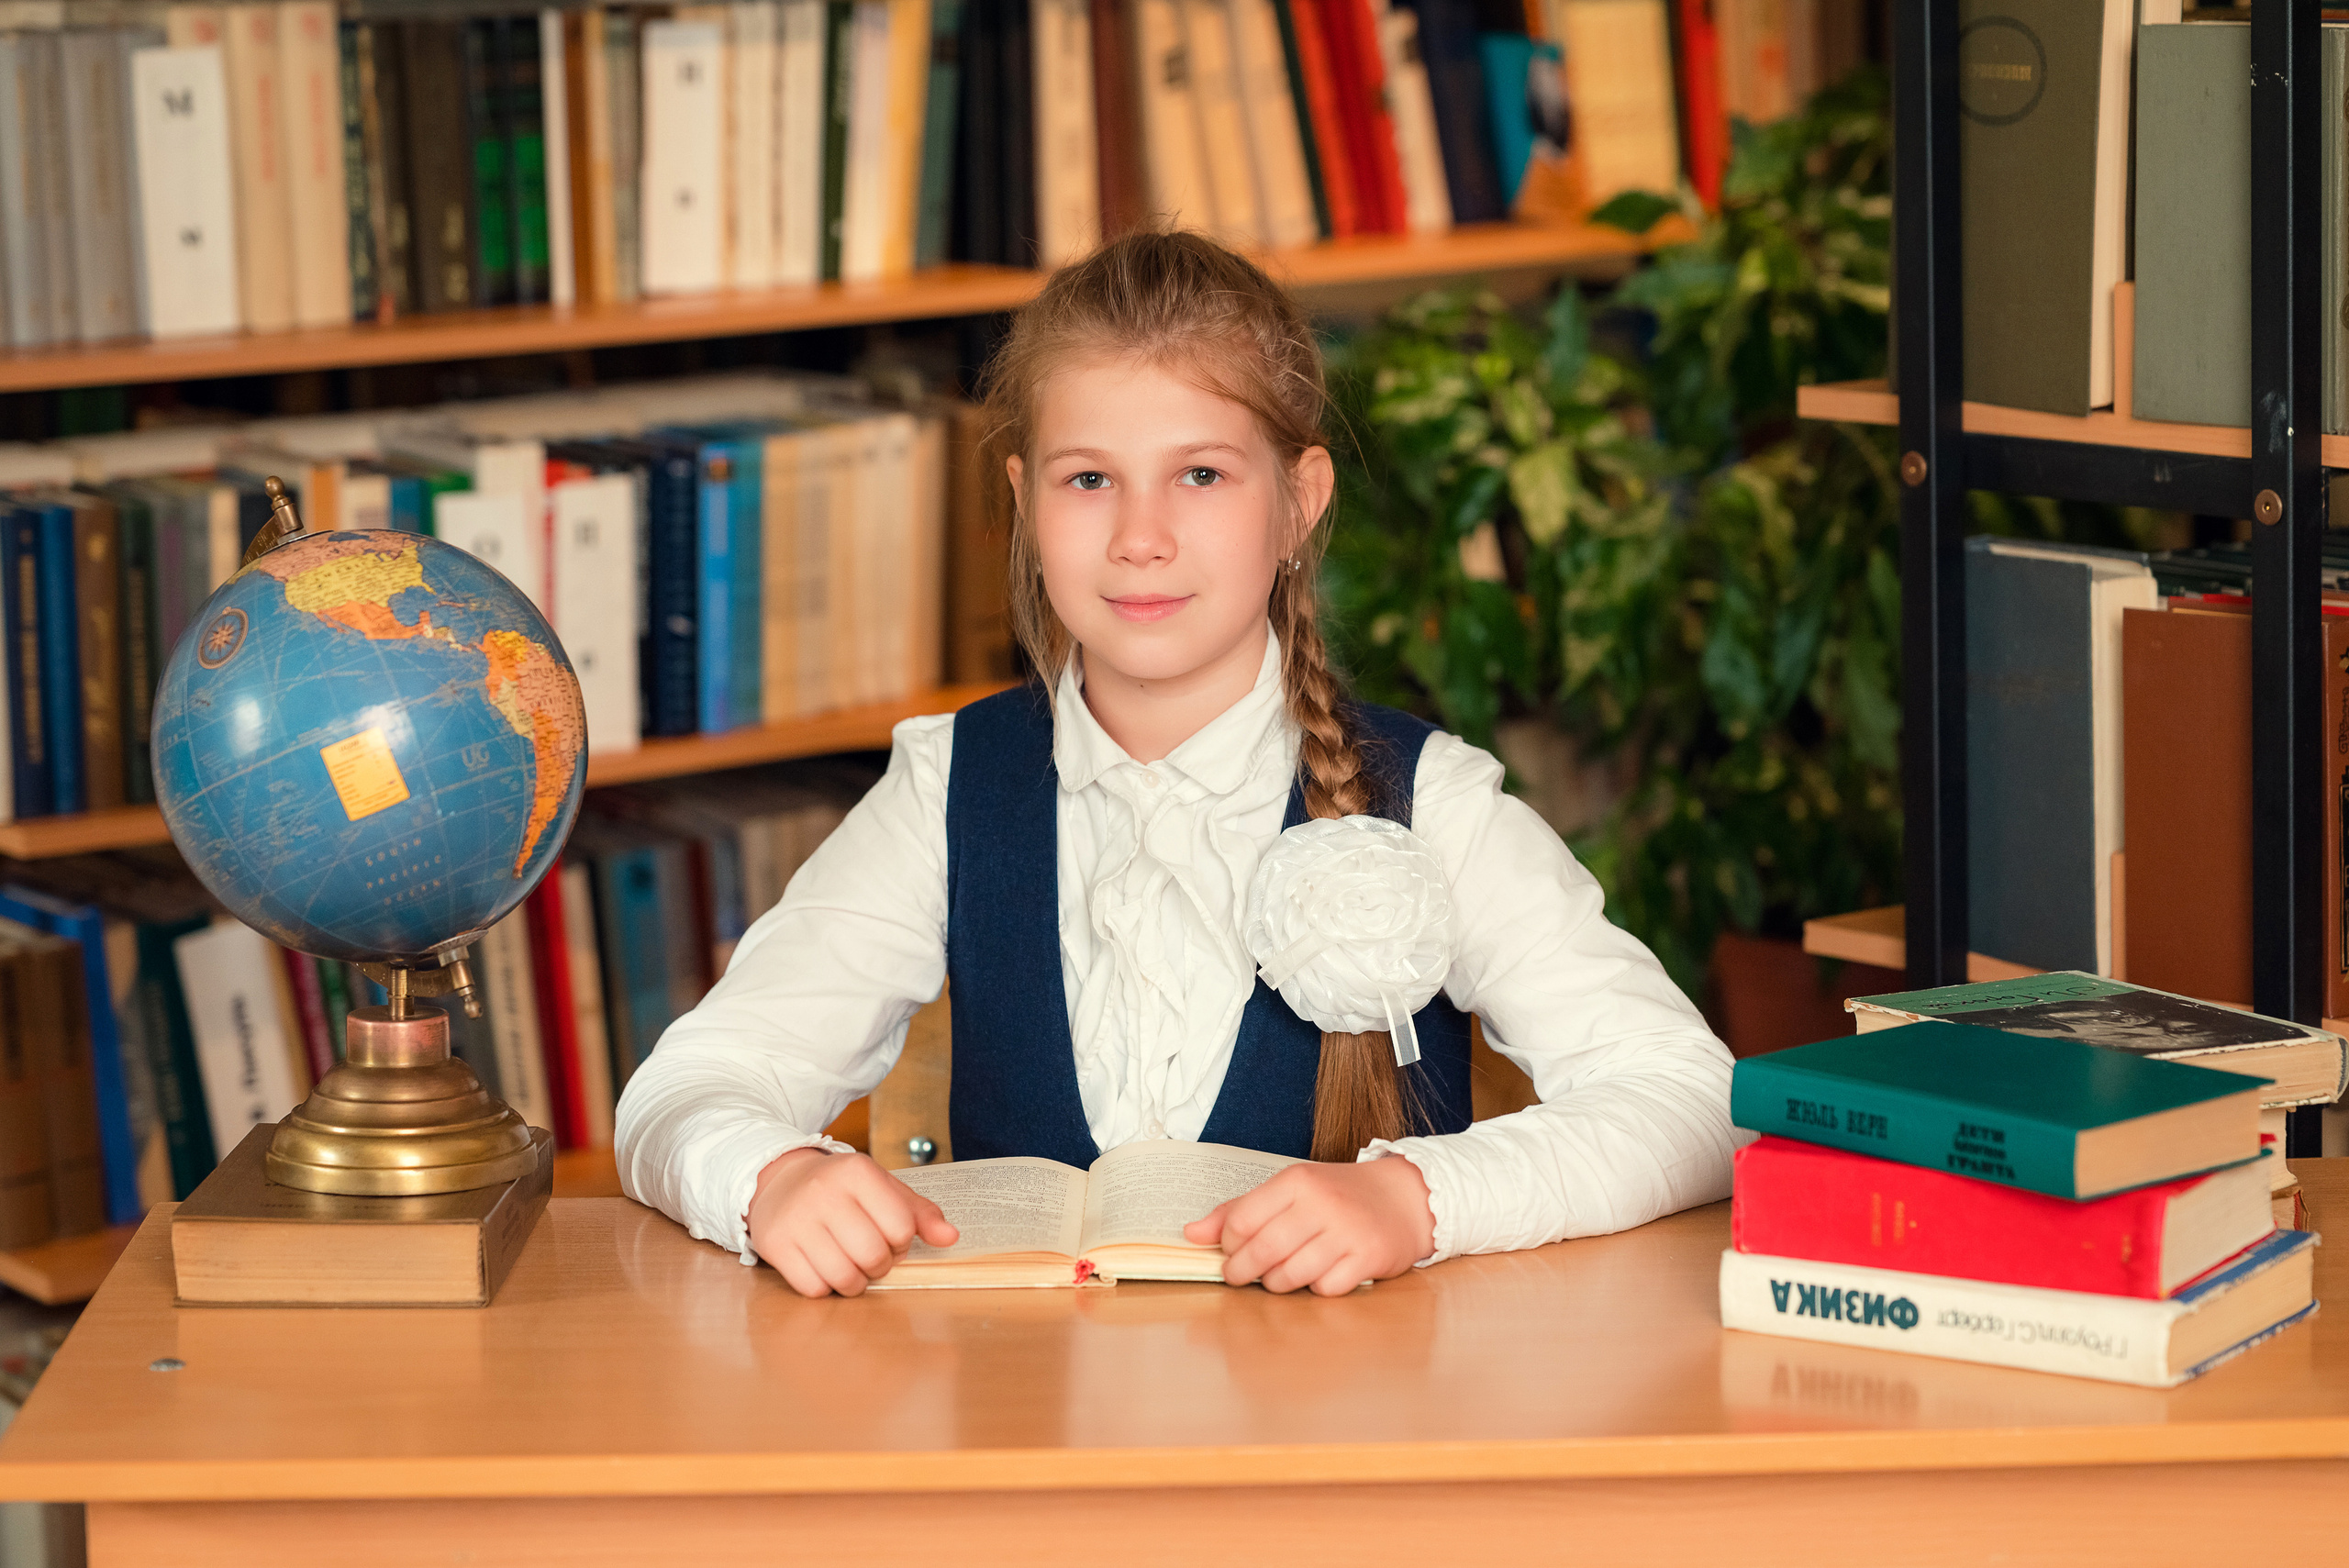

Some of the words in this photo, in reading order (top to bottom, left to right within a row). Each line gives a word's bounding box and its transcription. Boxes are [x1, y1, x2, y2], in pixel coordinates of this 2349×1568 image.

[462, 742, 490, 767] UG
[1786, 1097, 1839, 1130] ЖЮЛЬ
[1769, 1278, 1920, 1330] ФИЗИКА
